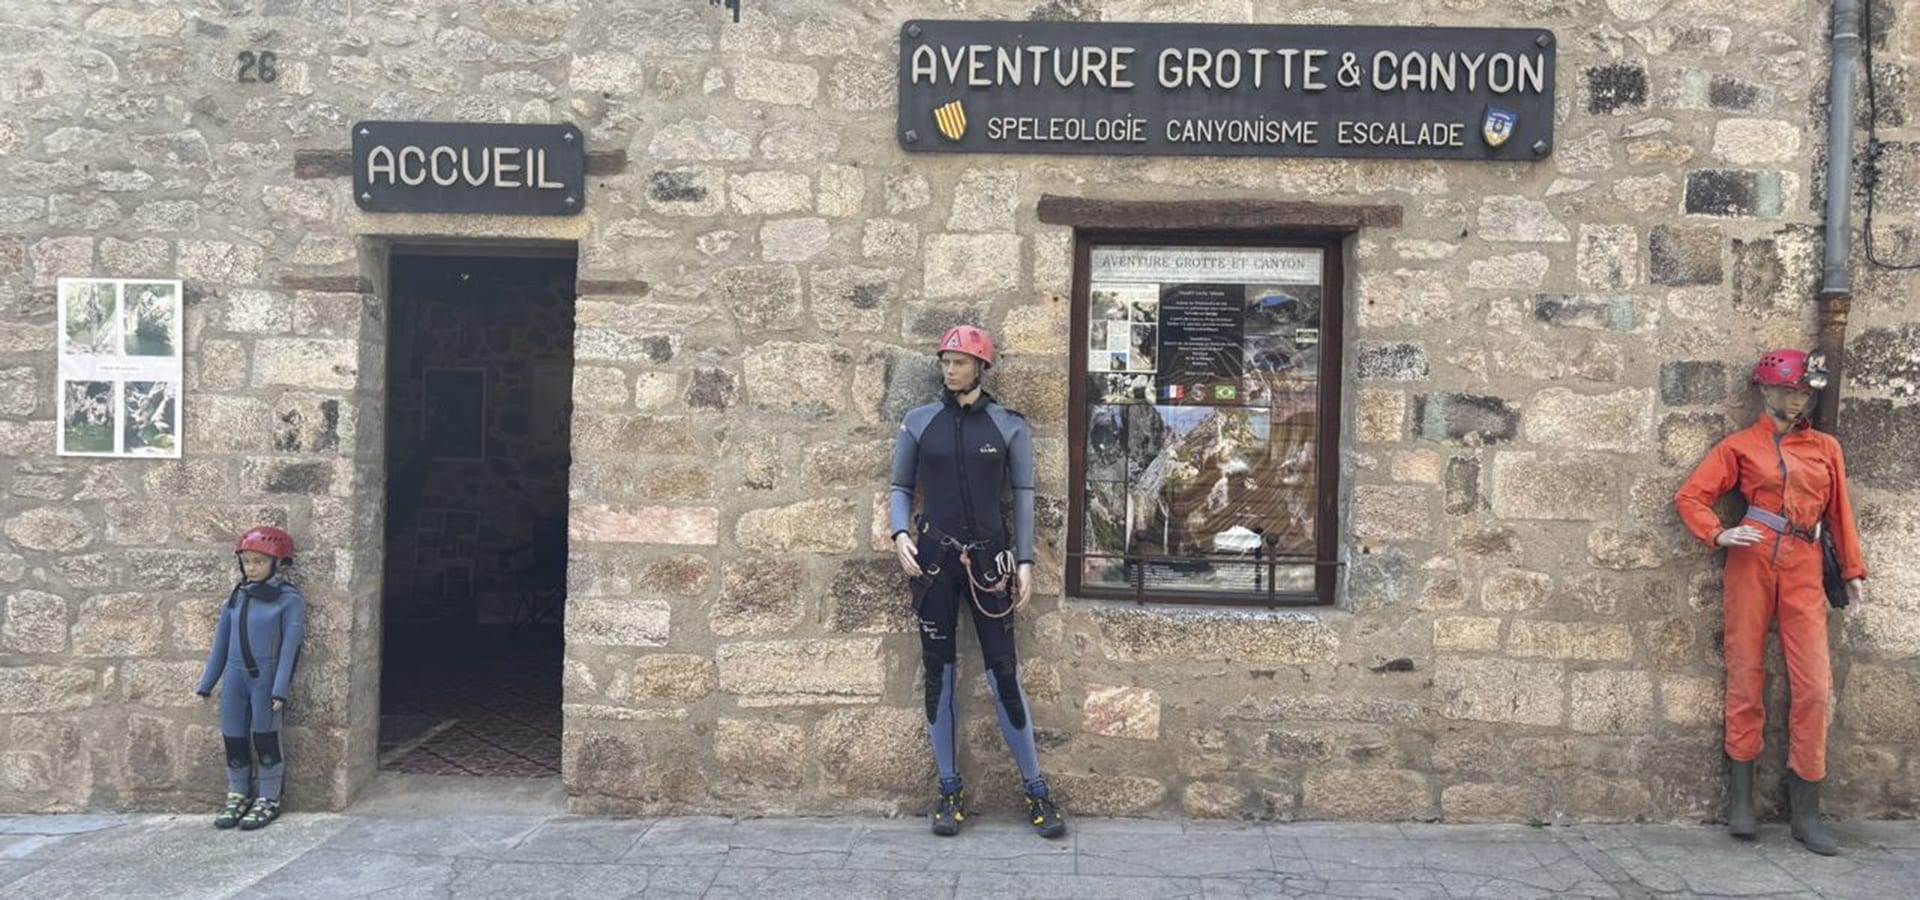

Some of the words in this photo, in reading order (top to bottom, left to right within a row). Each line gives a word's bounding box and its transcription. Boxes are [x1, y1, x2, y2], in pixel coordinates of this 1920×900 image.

[237, 50, 277, 84] 26
[911, 44, 1137, 88] AVENTURE
[1158, 47, 1329, 90] GROTTE
[1336, 51, 1362, 87] &
[1372, 50, 1545, 94] CANYON
[1337, 121, 1465, 146] ESCALADE
[367, 145, 565, 189] ACCUEIL
[1102, 254, 1170, 269] AVENTURE
[1175, 255, 1227, 270] GROTTE
[1231, 257, 1247, 270] ET
[1253, 257, 1306, 270] CANYON
